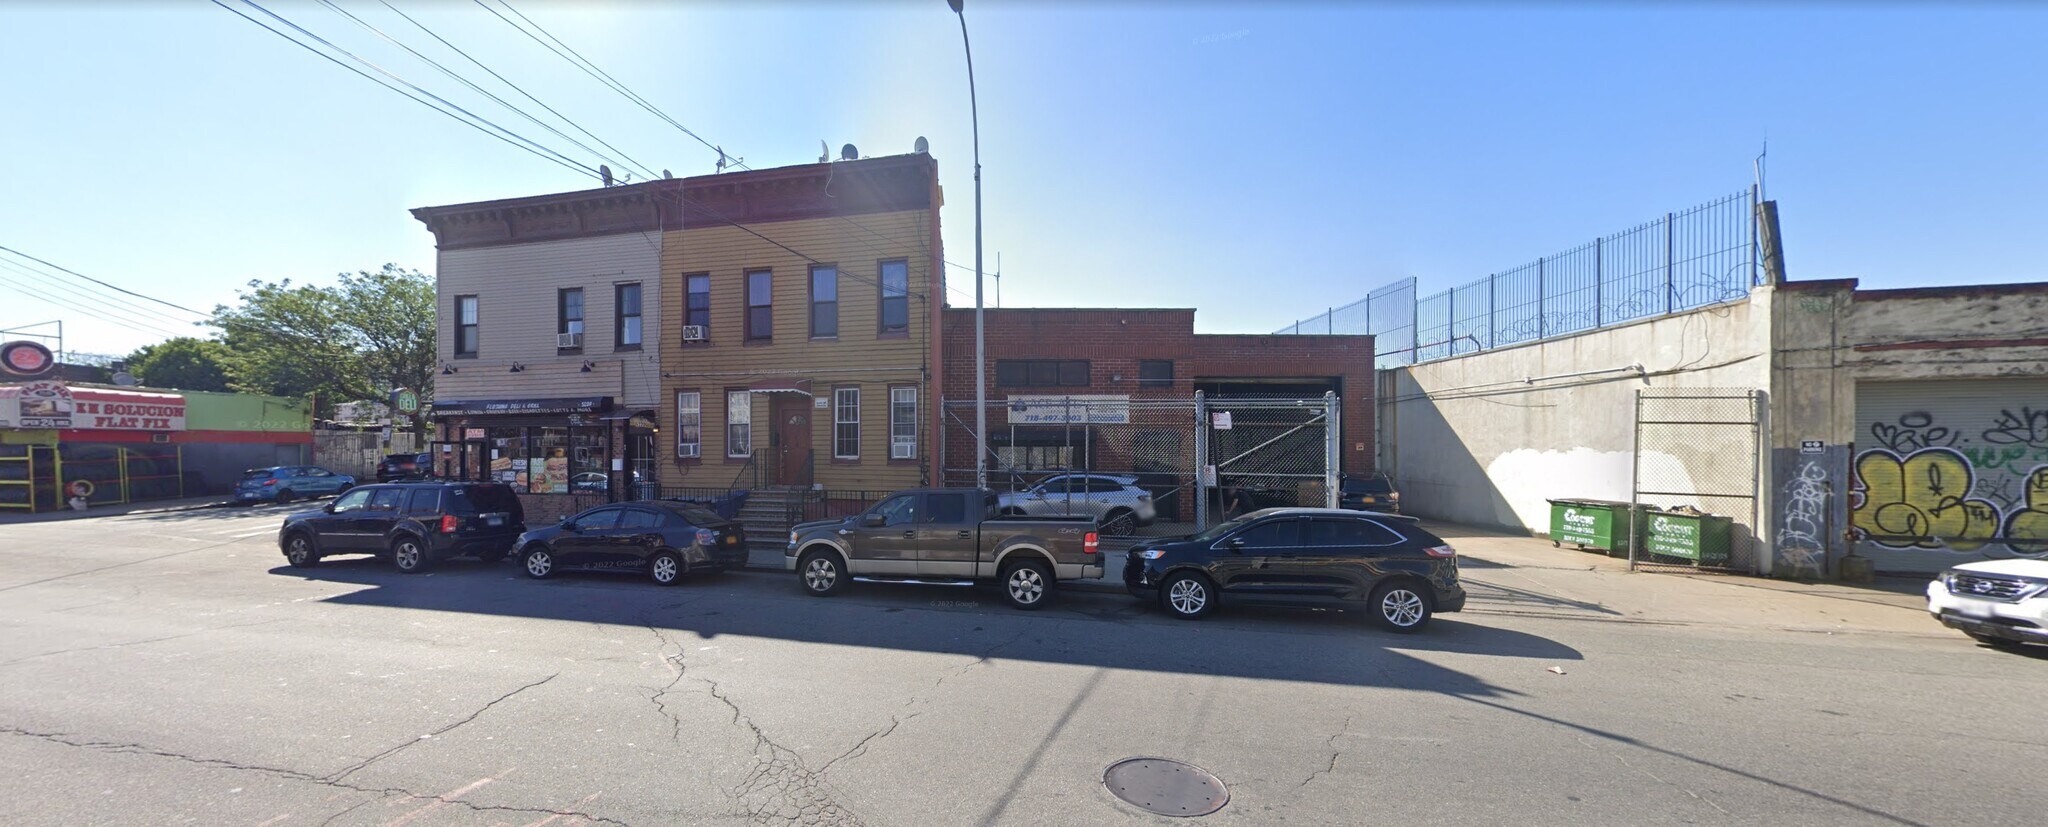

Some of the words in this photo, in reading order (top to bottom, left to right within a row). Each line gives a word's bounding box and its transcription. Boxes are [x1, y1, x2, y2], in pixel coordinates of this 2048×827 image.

[399, 398, 417, 410] DELI
[103, 403, 185, 418] SOLUCION
[40, 418, 55, 428] 24
[94, 416, 139, 429] FLAT
[142, 418, 171, 429] FIX
